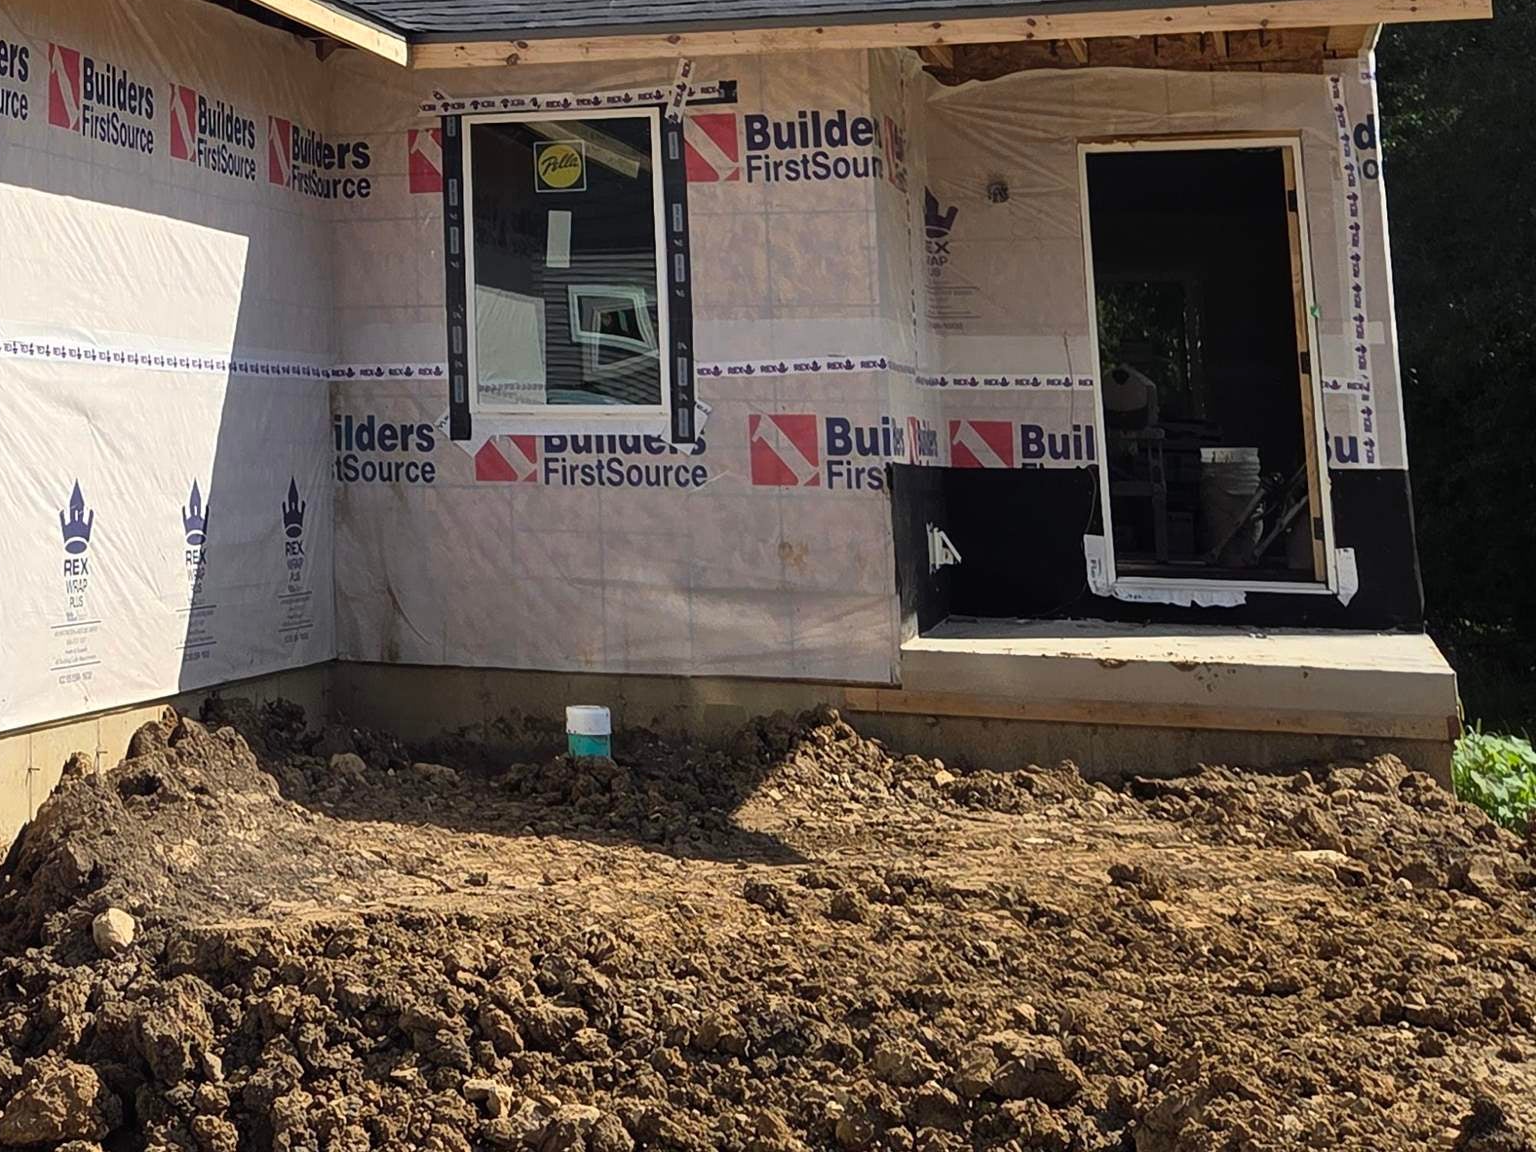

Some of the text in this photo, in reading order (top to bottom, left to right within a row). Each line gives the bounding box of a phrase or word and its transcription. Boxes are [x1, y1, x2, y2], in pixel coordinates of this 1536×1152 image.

[83, 56, 154, 120] Builders
[82, 104, 154, 155] FirstSource
[198, 94, 256, 150] Builders
[197, 137, 256, 182] FirstSource
[292, 124, 371, 170] Builders
[541, 152, 579, 176] Pella
[544, 456, 708, 488] FirstSource
[64, 557, 89, 577] REX
